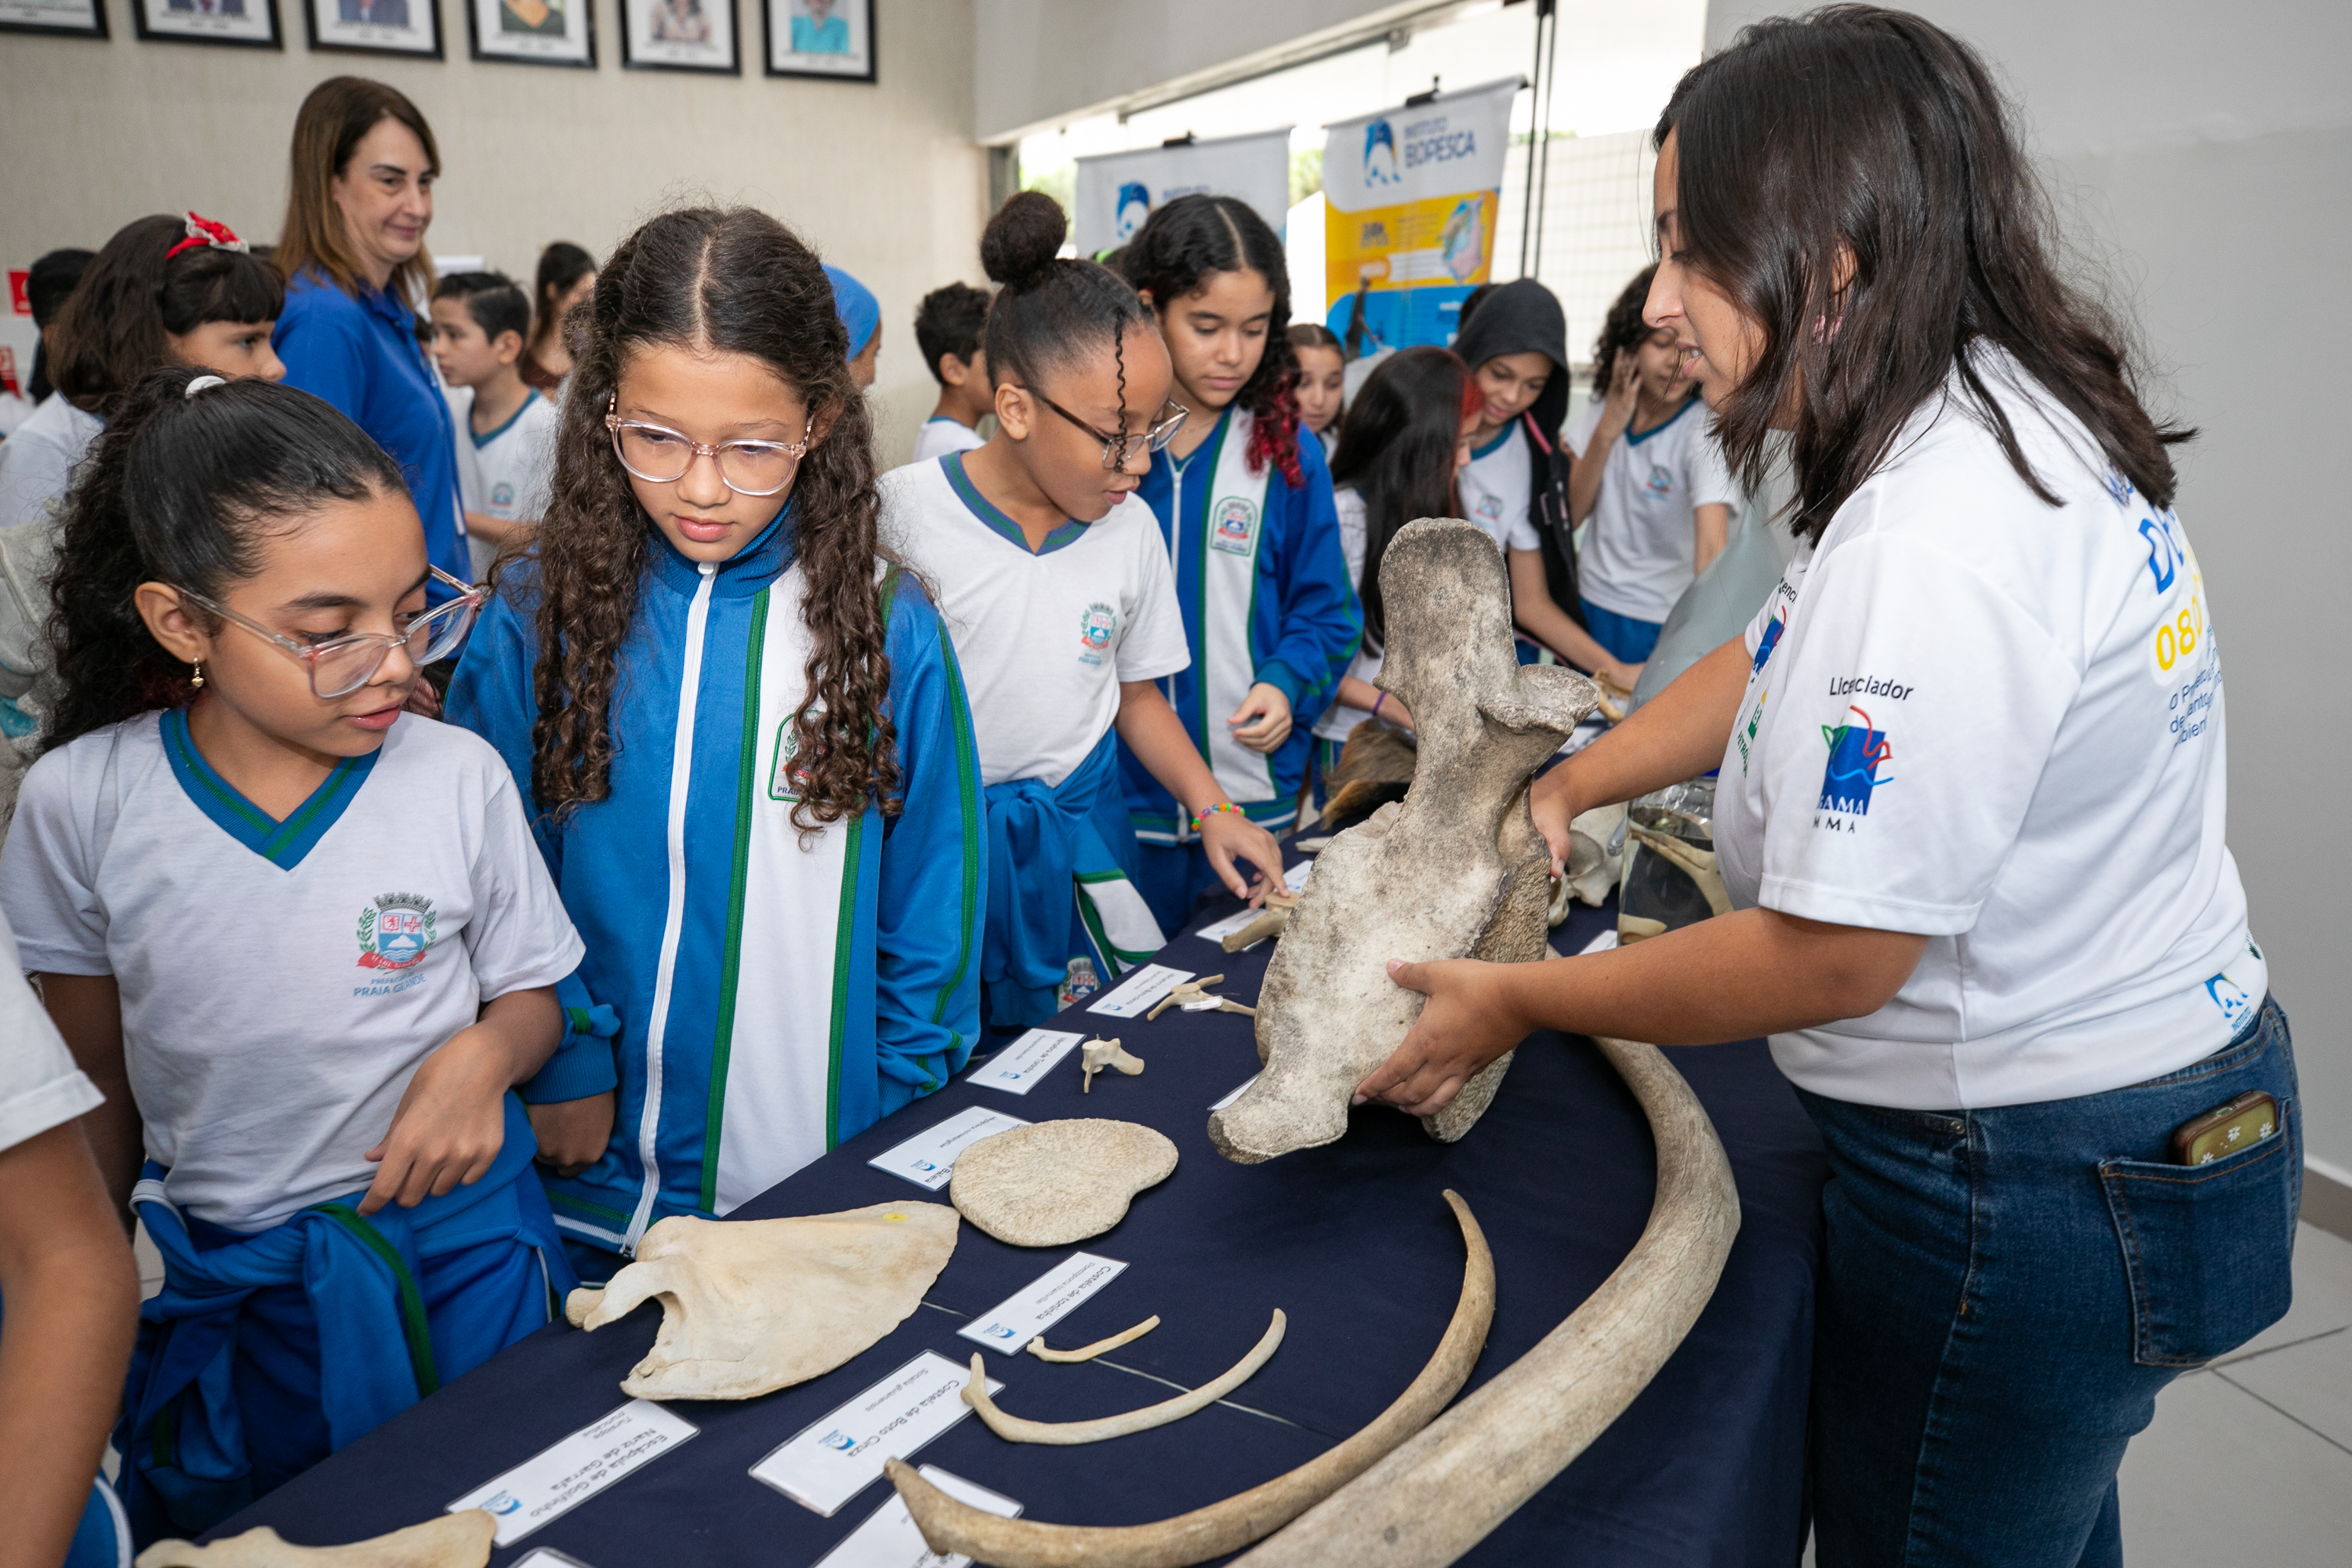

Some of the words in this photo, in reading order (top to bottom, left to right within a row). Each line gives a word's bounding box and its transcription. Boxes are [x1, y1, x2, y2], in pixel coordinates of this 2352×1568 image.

[353, 985, 391, 996] PRAIA
[393, 973, 426, 993] GRANDE
[925, 1167, 951, 1184] Baleia
[1078, 1266, 1112, 1289] Costela
[1067, 1289, 1081, 1298] de
[1036, 1298, 1071, 1320] toninha
[919, 1379, 960, 1408] Costela
[904, 1406, 920, 1417] de
[879, 1416, 908, 1436] Boto
[621, 1428, 657, 1449] Nariz
[846, 1435, 881, 1458] Cinza
[603, 1447, 620, 1459] de
[608, 1434, 668, 1469] Escápula
[550, 1459, 603, 1490] Garrafa
[590, 1468, 608, 1482] de
[529, 1481, 590, 1518] Golfinho
